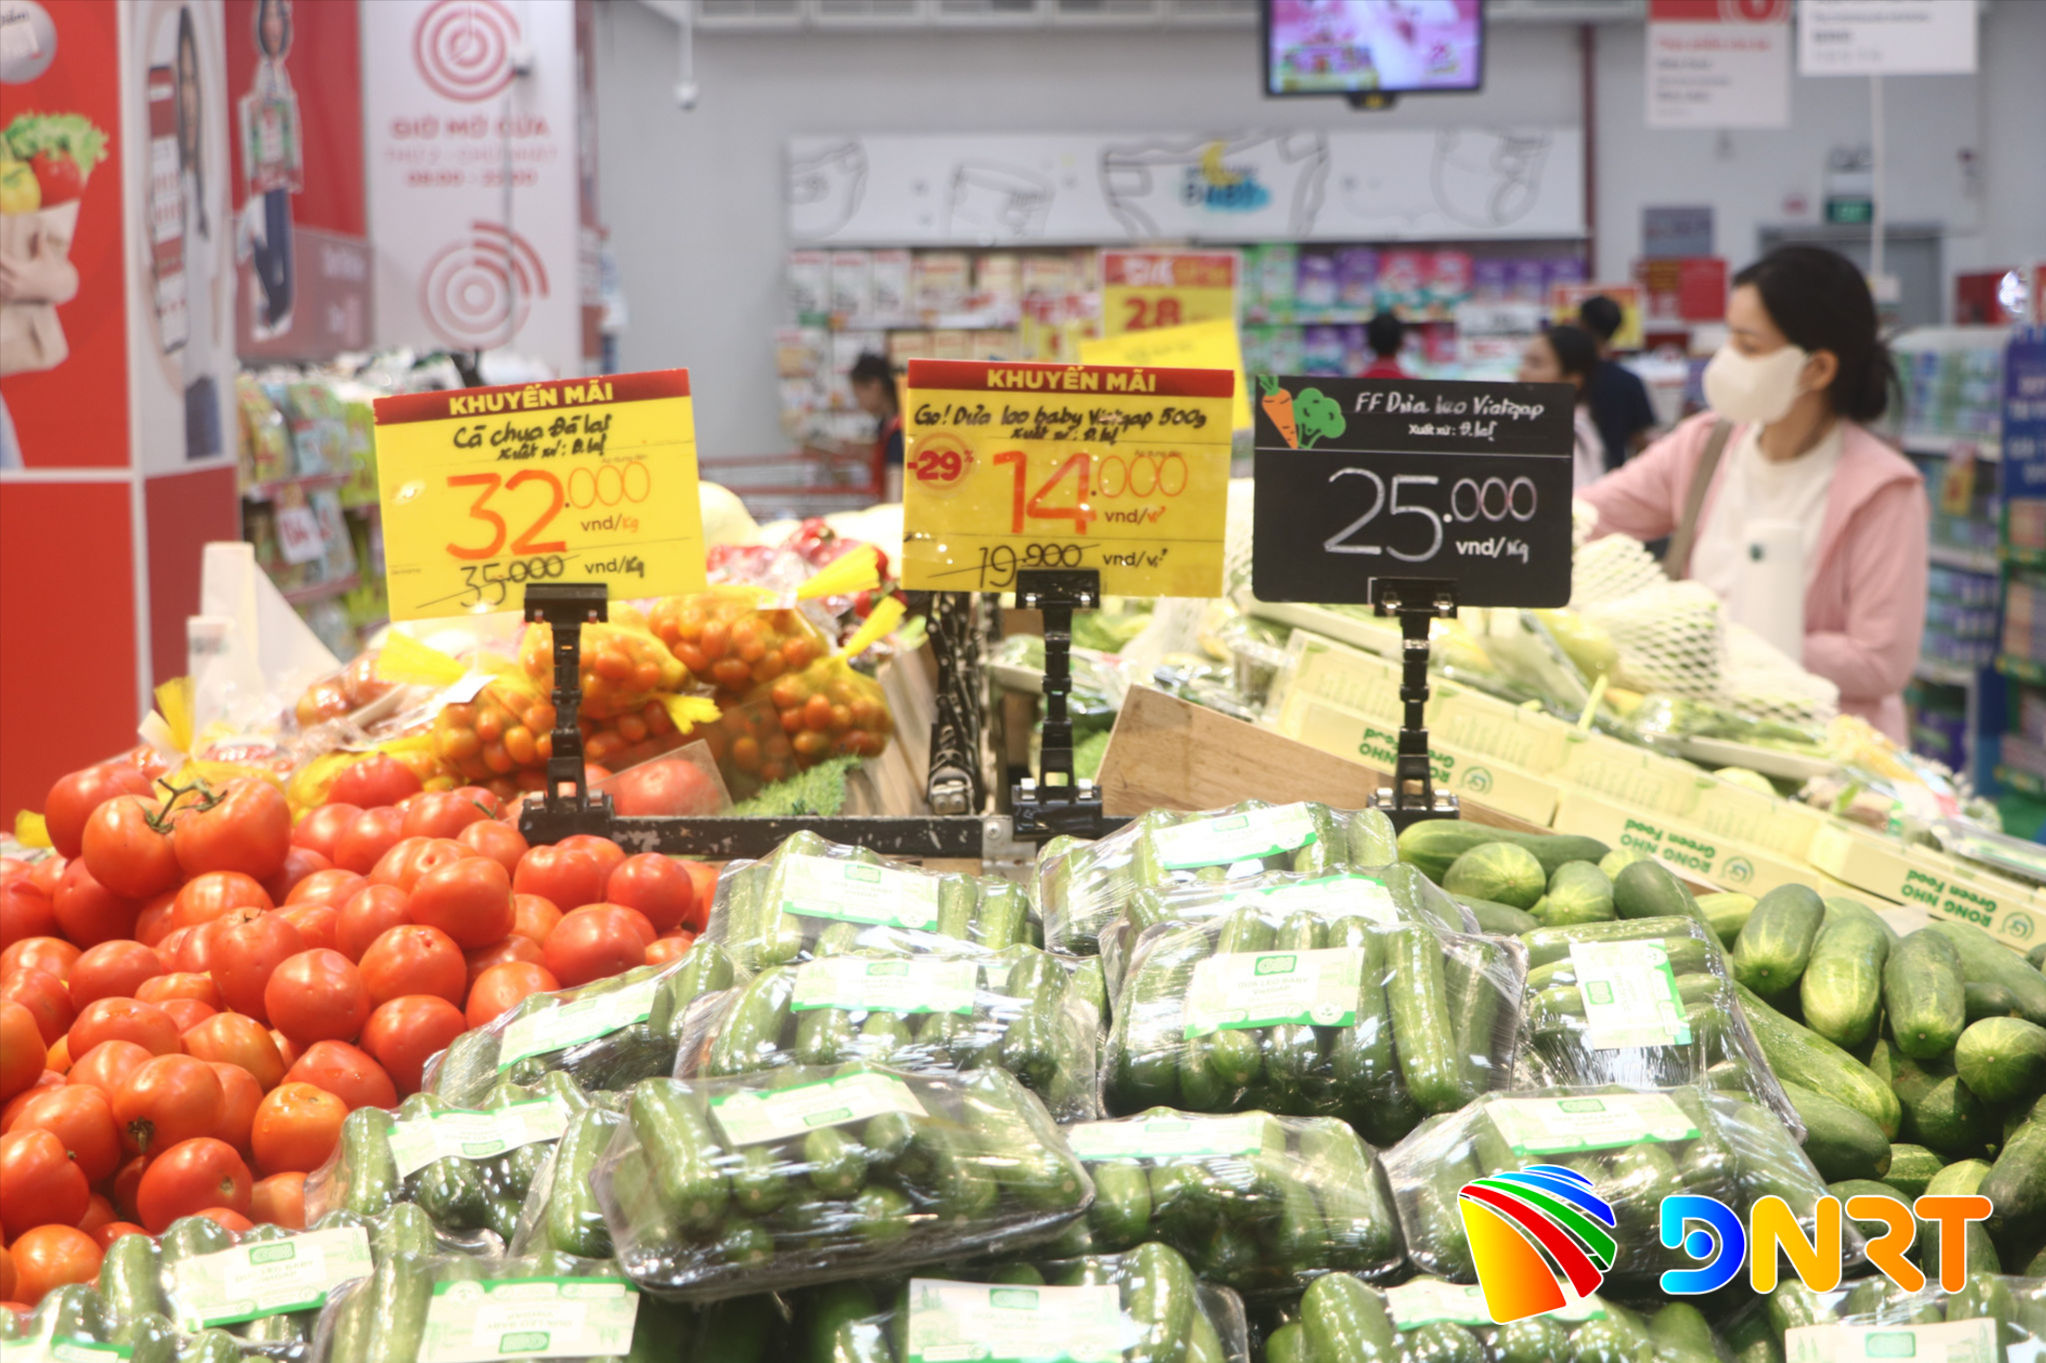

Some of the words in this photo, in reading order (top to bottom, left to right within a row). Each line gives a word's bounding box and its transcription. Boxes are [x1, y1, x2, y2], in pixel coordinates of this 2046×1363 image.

[987, 366, 1099, 391] KHUYẾN
[1106, 367, 1157, 393] MÃI
[450, 383, 558, 416] KHUYẾN
[564, 379, 614, 405] MÃI
[993, 450, 1188, 535] 14.000
[446, 460, 651, 560] 32.000
[1323, 467, 1538, 563] 25.000
[1624, 818, 1664, 841] Food
[1668, 832, 1716, 859] Green
[1906, 869, 1945, 894] Food
[1901, 884, 1939, 908] NHO
[1949, 886, 1997, 913] Green
[1943, 900, 1993, 928] RONG
